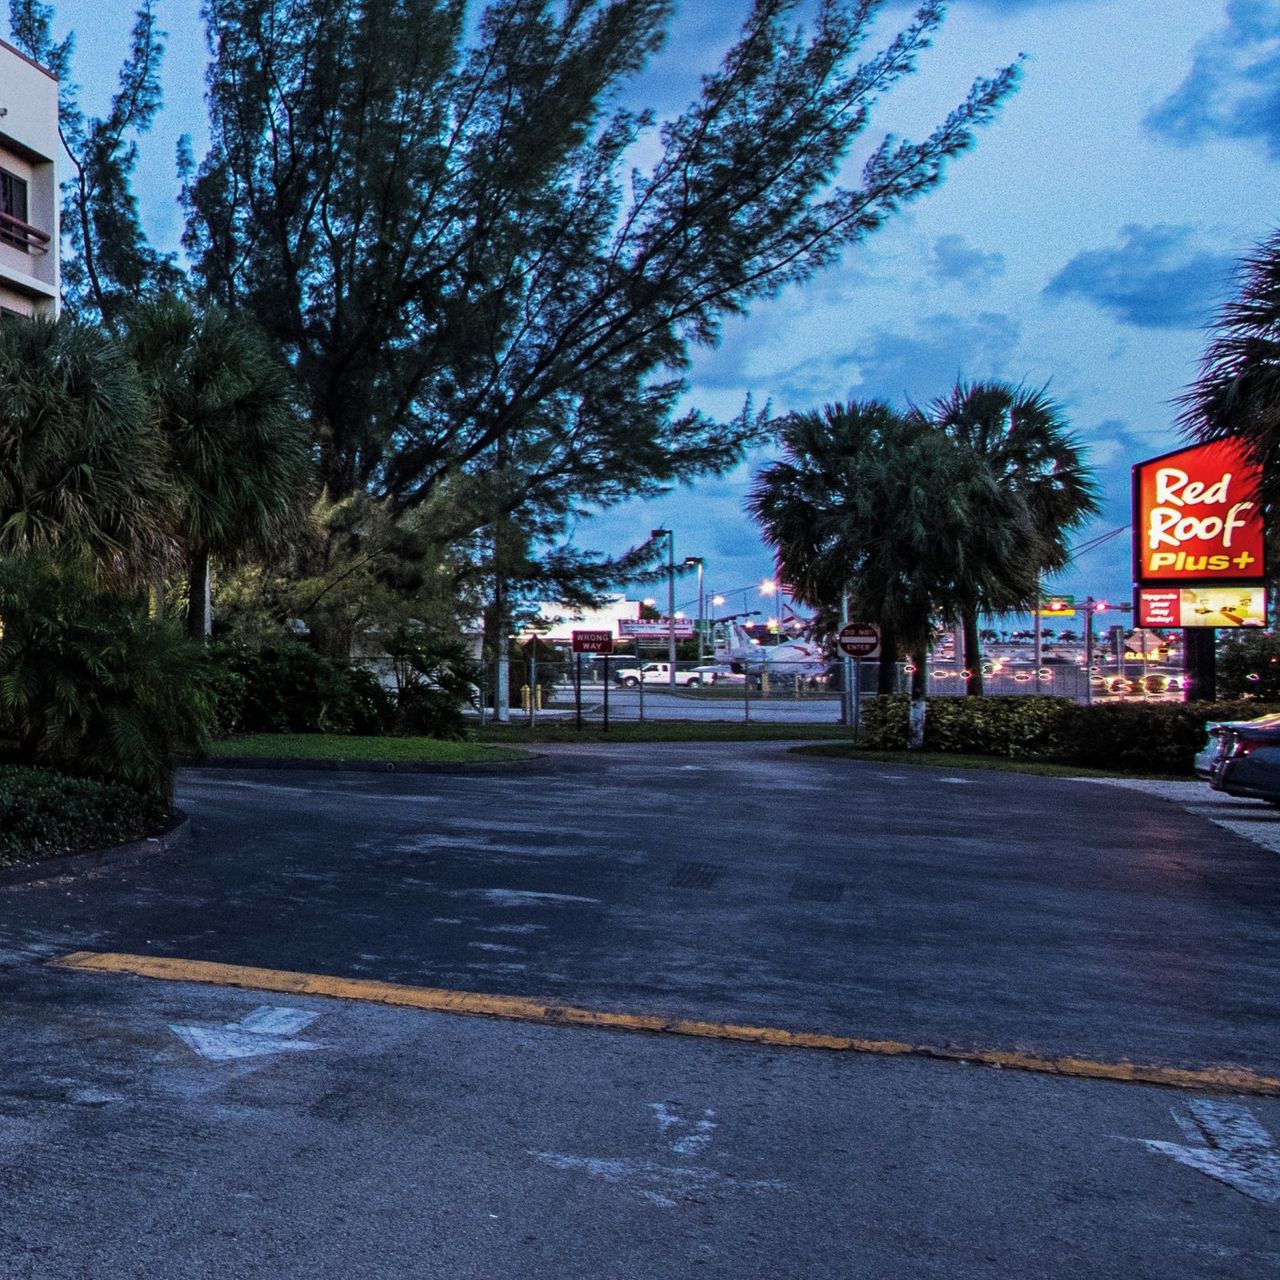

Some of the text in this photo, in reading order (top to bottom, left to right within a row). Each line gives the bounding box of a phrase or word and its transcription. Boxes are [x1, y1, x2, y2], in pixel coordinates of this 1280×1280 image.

[1155, 468, 1232, 507] Red
[1148, 501, 1255, 550] Roof
[1149, 551, 1255, 572] Plus+
[576, 633, 609, 641] WRONG
[582, 642, 602, 650] WAY
